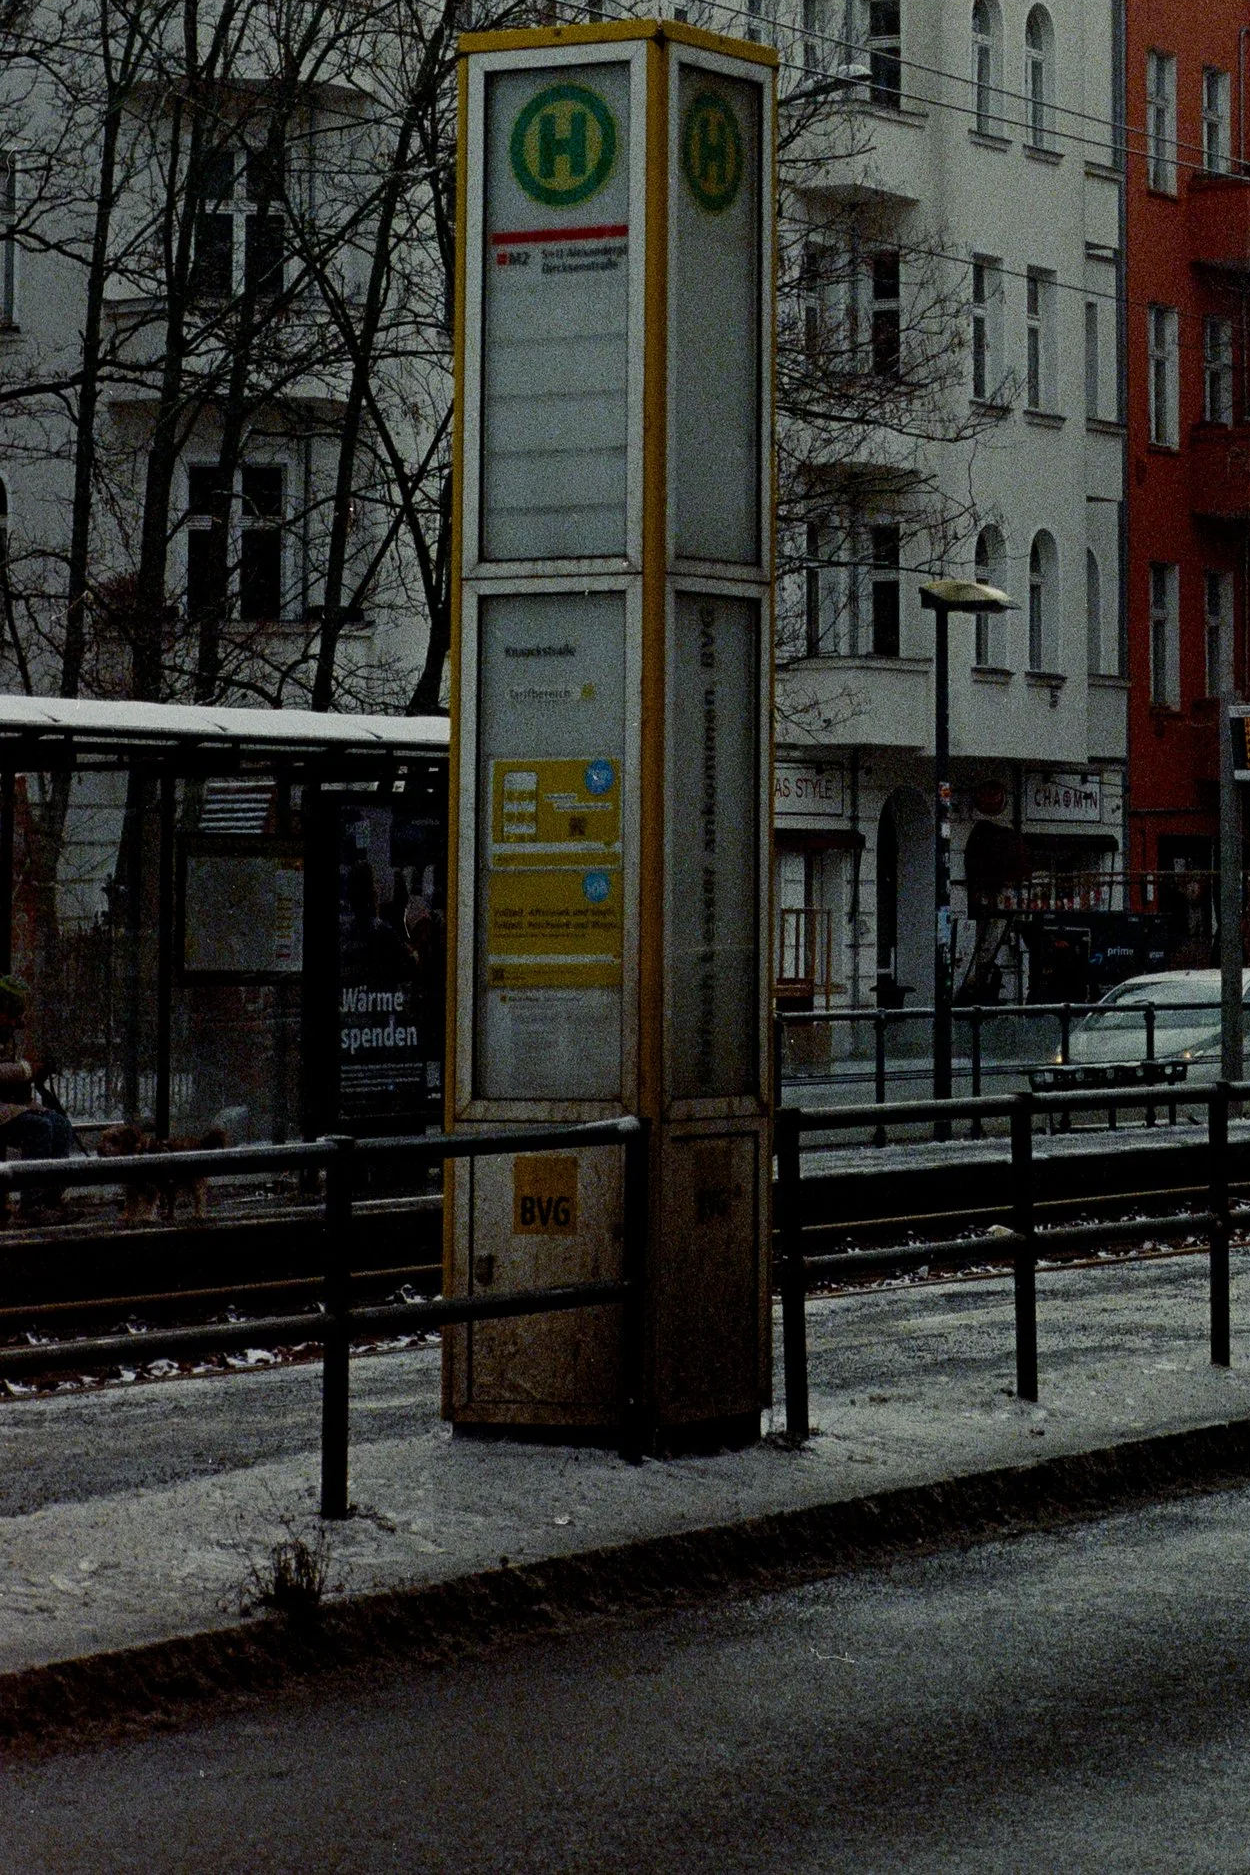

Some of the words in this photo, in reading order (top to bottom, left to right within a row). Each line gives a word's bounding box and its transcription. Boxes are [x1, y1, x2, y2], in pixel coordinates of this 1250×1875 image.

[538, 112, 587, 180] H
[509, 252, 531, 265] M2
[796, 778, 833, 800] STYLE
[1106, 945, 1135, 958] prime
[339, 984, 405, 1013] Wärme
[340, 1014, 419, 1055] spenden
[519, 1195, 571, 1228] BVG
